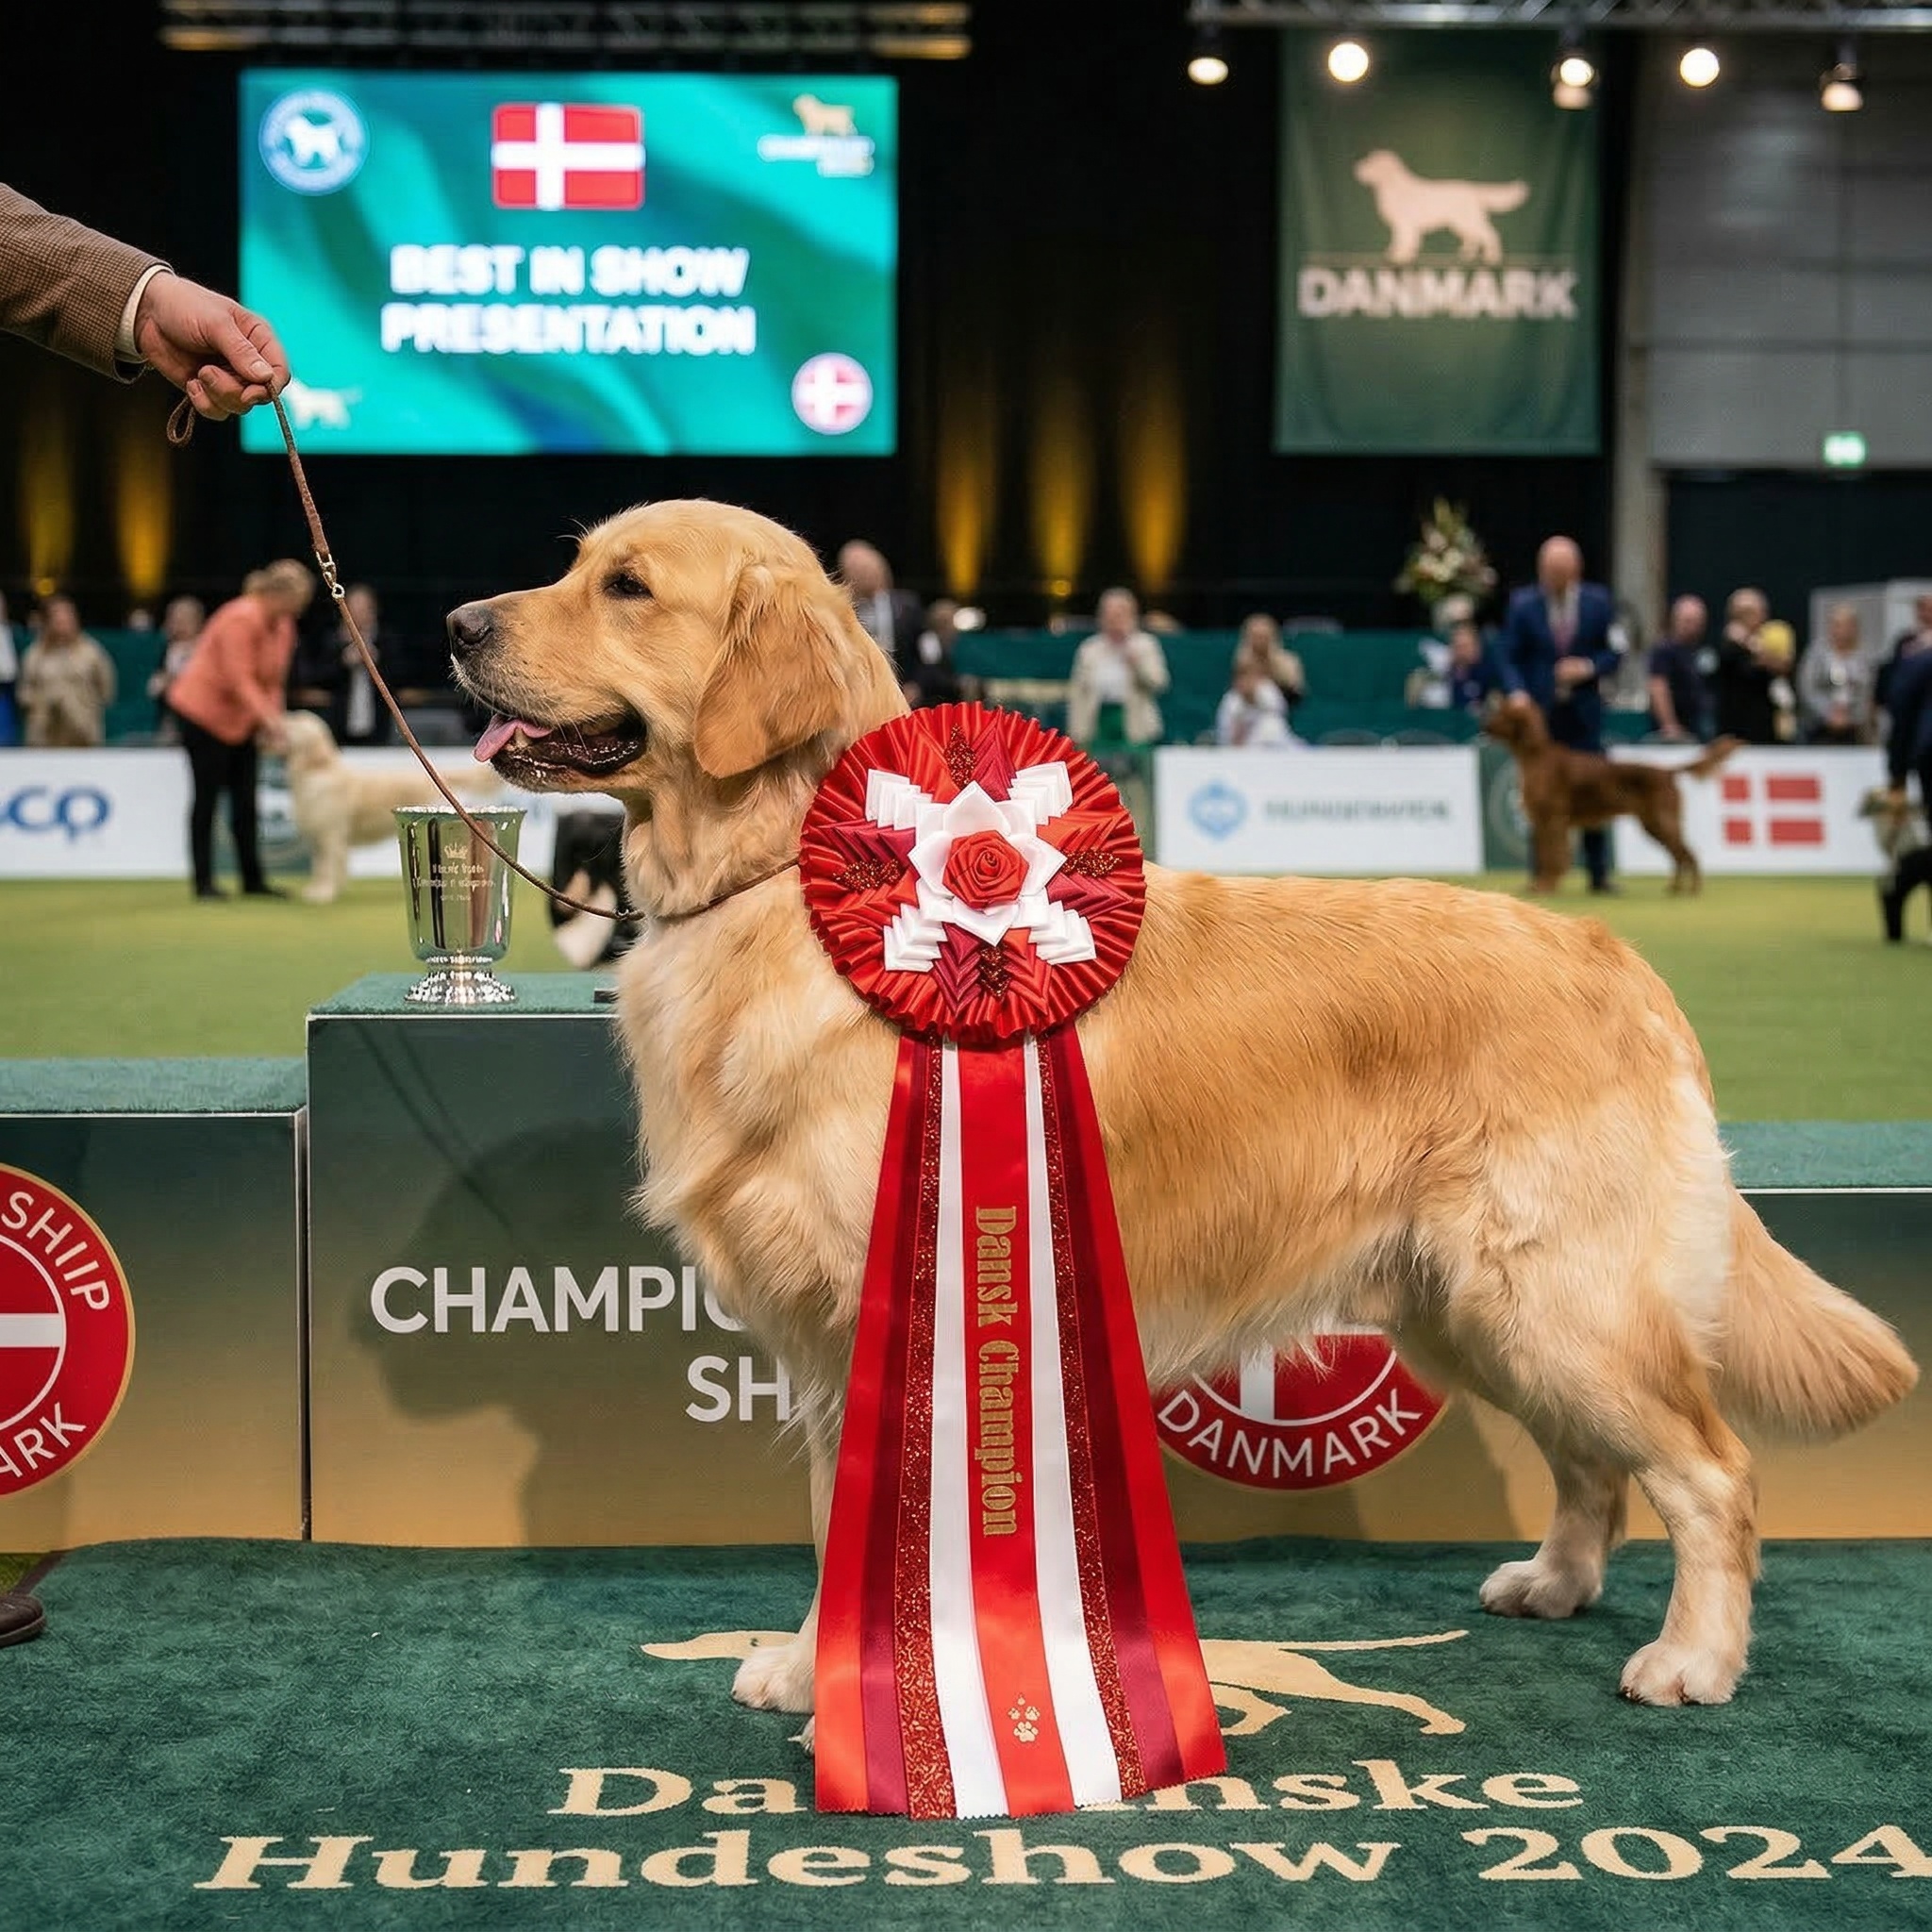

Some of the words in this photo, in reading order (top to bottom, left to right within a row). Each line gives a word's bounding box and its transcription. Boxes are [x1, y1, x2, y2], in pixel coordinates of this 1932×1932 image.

[391, 244, 523, 293] BEST
[530, 246, 585, 294] IN
[591, 245, 749, 296] SHOW
[1296, 266, 1578, 319] DANMARK
[381, 304, 756, 355] PRESENTATION
[974, 1206, 1019, 1328] Dansk
[685, 1355, 791, 1423] SH
[974, 1340, 1024, 1538] Champion
[1158, 1387, 1424, 1479] DANMARK
[193, 1827, 1403, 1889] Hundeshow
[1460, 1824, 1932, 1881] 2024
